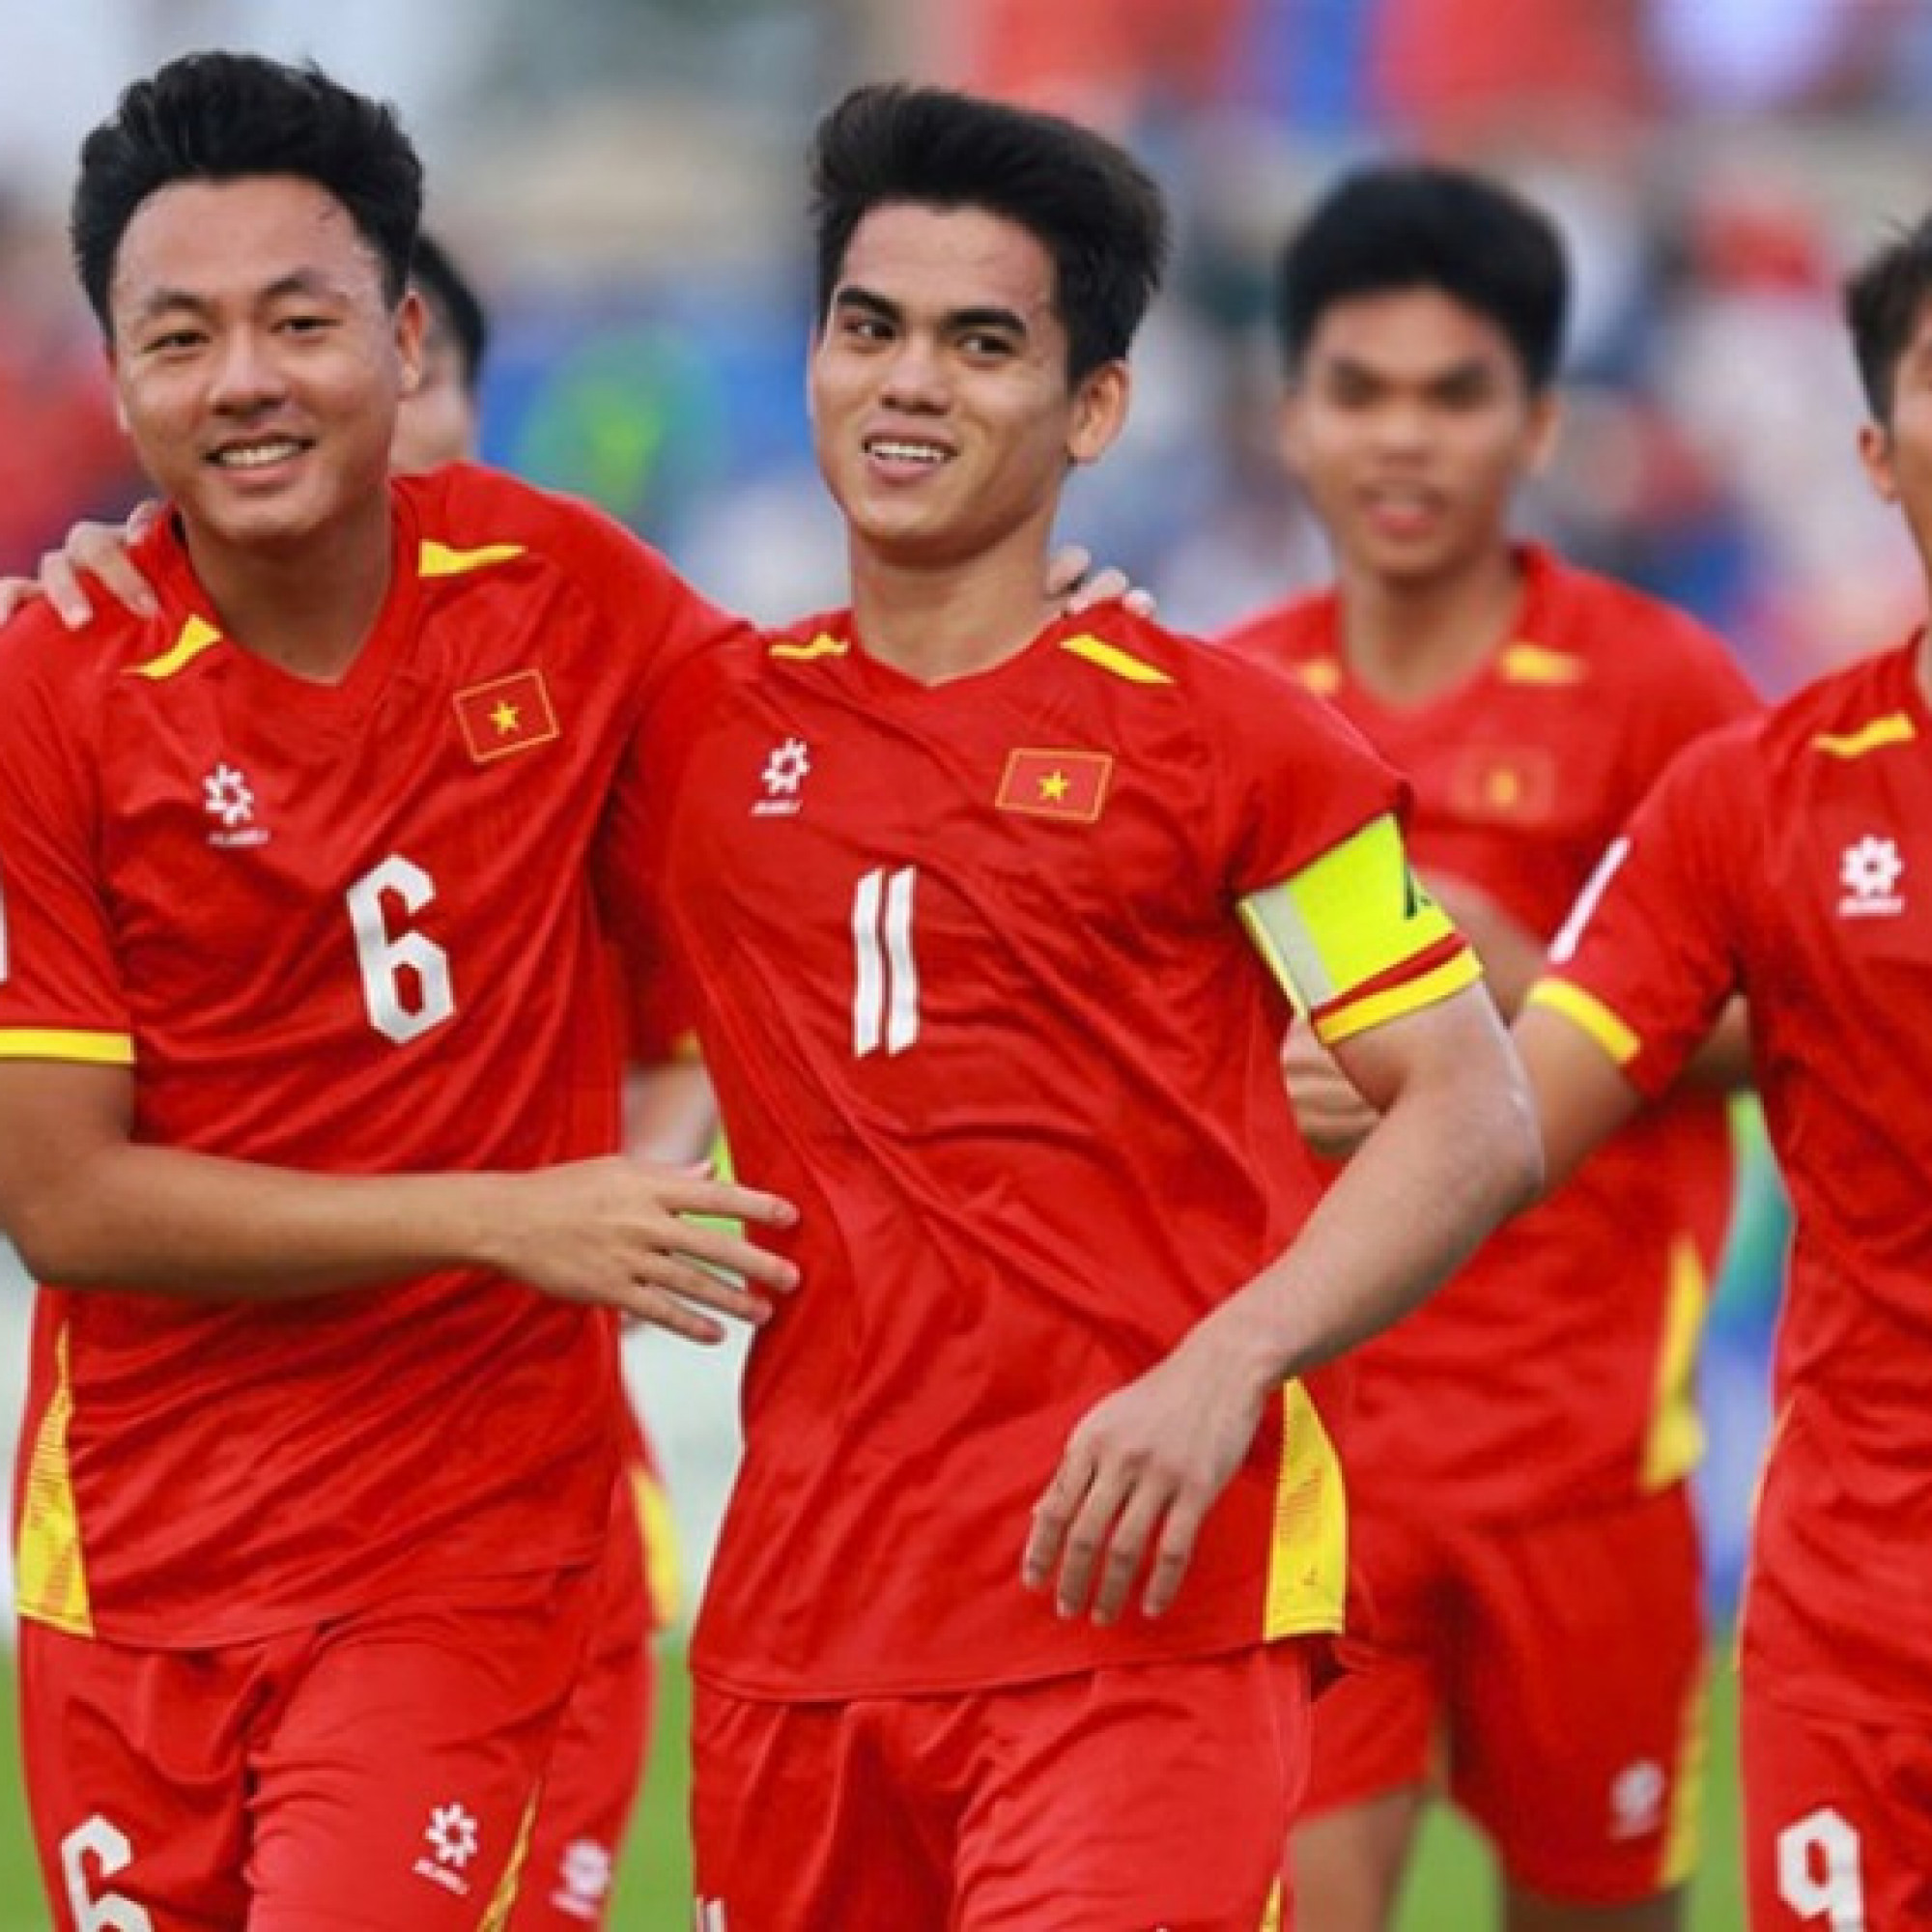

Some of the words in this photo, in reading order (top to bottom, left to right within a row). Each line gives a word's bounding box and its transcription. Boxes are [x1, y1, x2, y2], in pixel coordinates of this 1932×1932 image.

[346, 854, 457, 1044] 6
[850, 867, 921, 1058] 11
[60, 1814, 154, 1932] 6
[1776, 1807, 1864, 1932] 9
